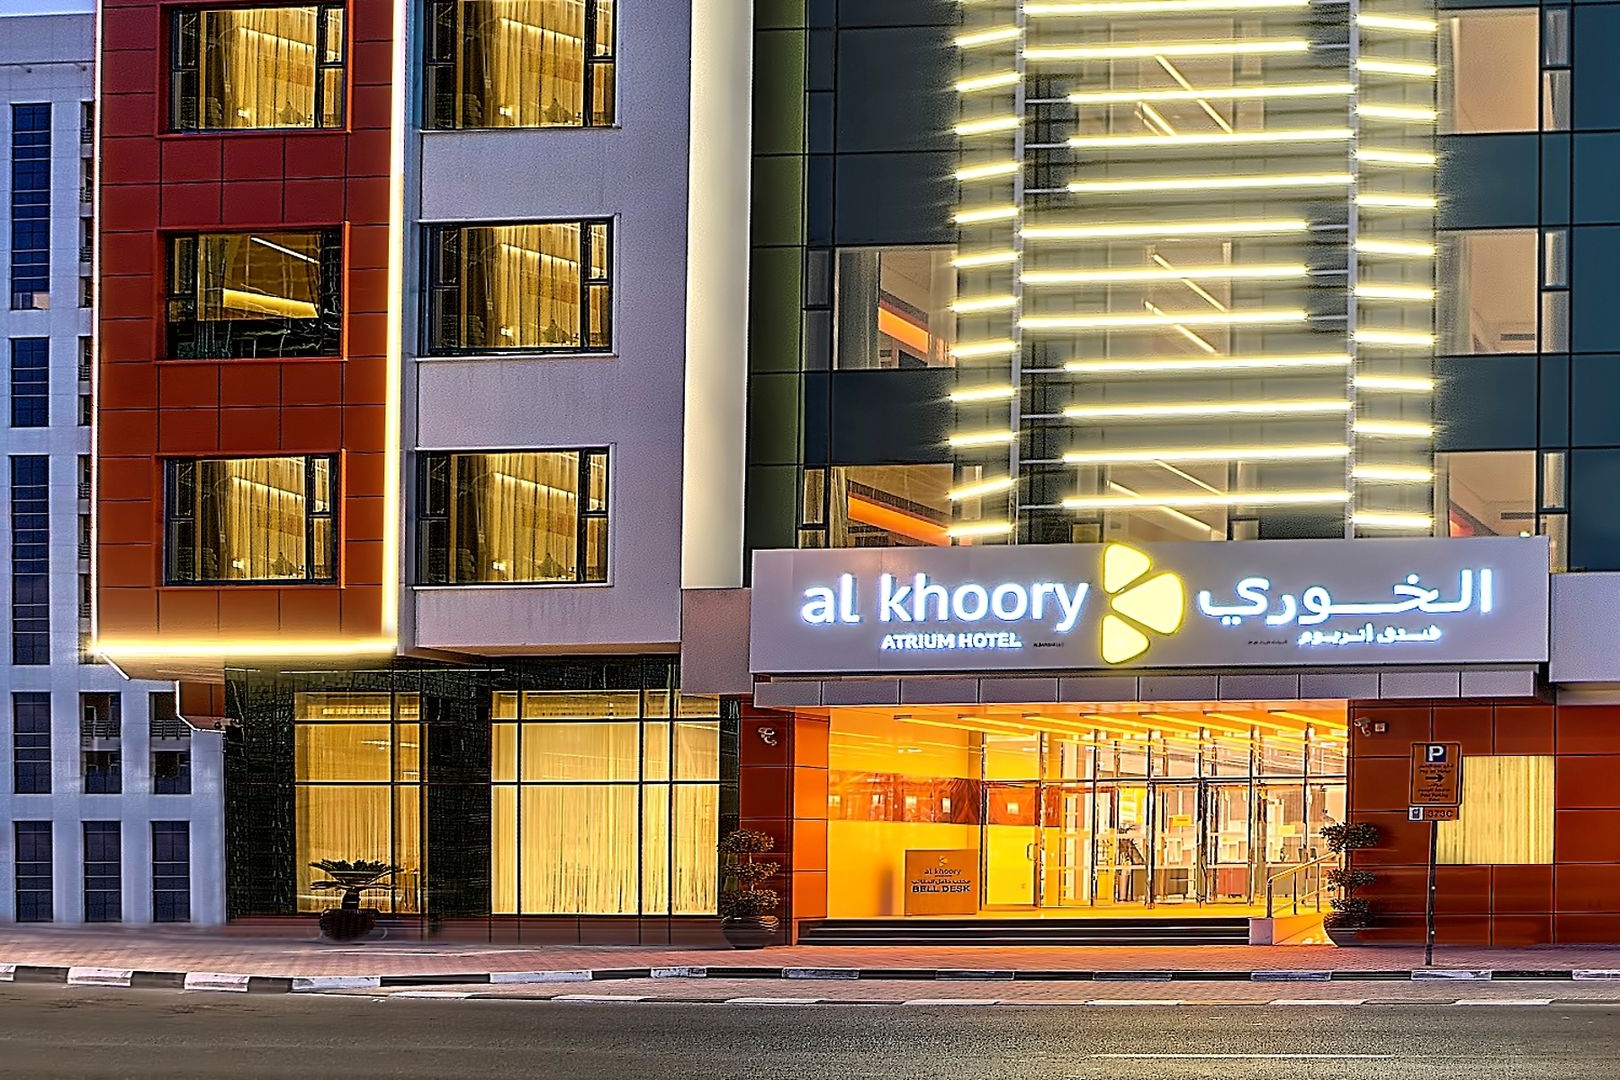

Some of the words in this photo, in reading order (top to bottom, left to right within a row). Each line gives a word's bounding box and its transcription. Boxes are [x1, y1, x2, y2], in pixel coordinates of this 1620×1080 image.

[800, 573, 860, 624] al
[879, 573, 1090, 632] khoory
[1198, 568, 1493, 625] الخوري
[881, 633, 955, 650] ATRIUM
[957, 632, 1023, 649] HOTEL
[1428, 745, 1444, 761] P
[912, 885, 940, 893] BELL
[942, 885, 970, 893] DESK
